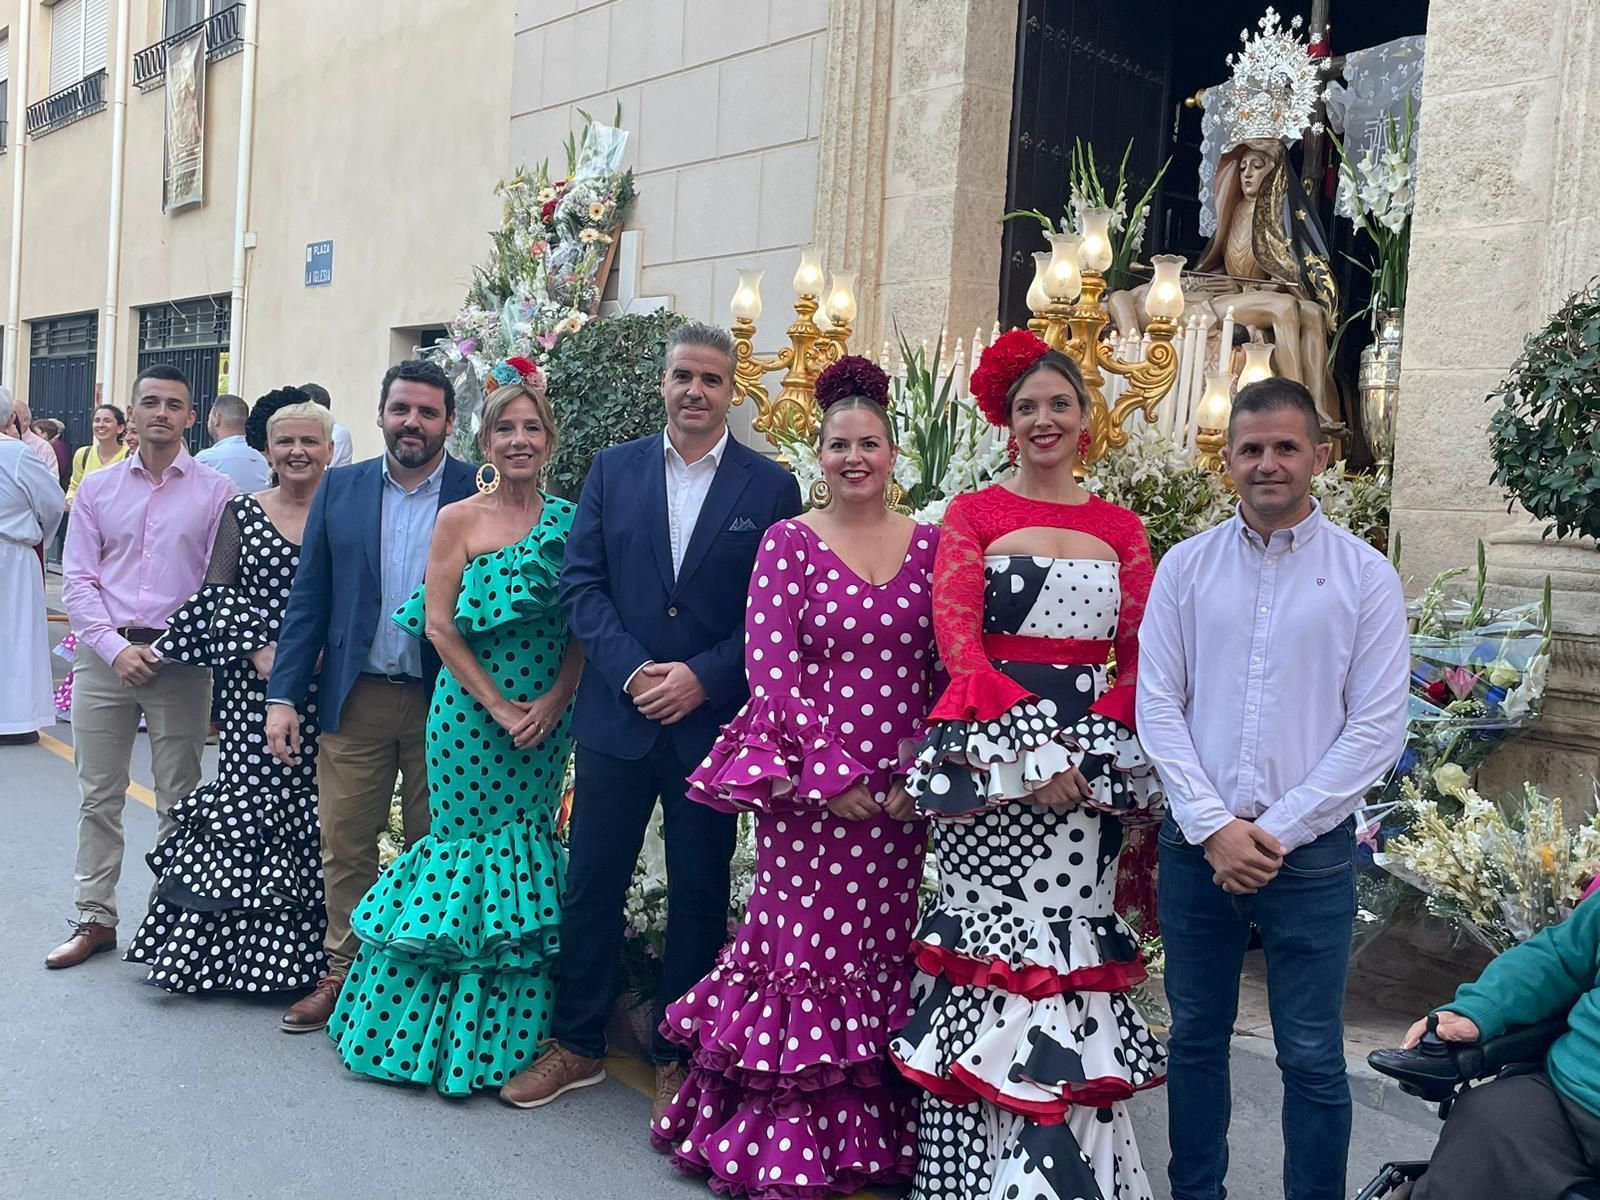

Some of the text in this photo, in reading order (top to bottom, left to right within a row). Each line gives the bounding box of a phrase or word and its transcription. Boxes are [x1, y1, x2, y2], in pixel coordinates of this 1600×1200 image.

[313, 243, 330, 255] PLAZA
[305, 269, 331, 284] LA IGLESIA
